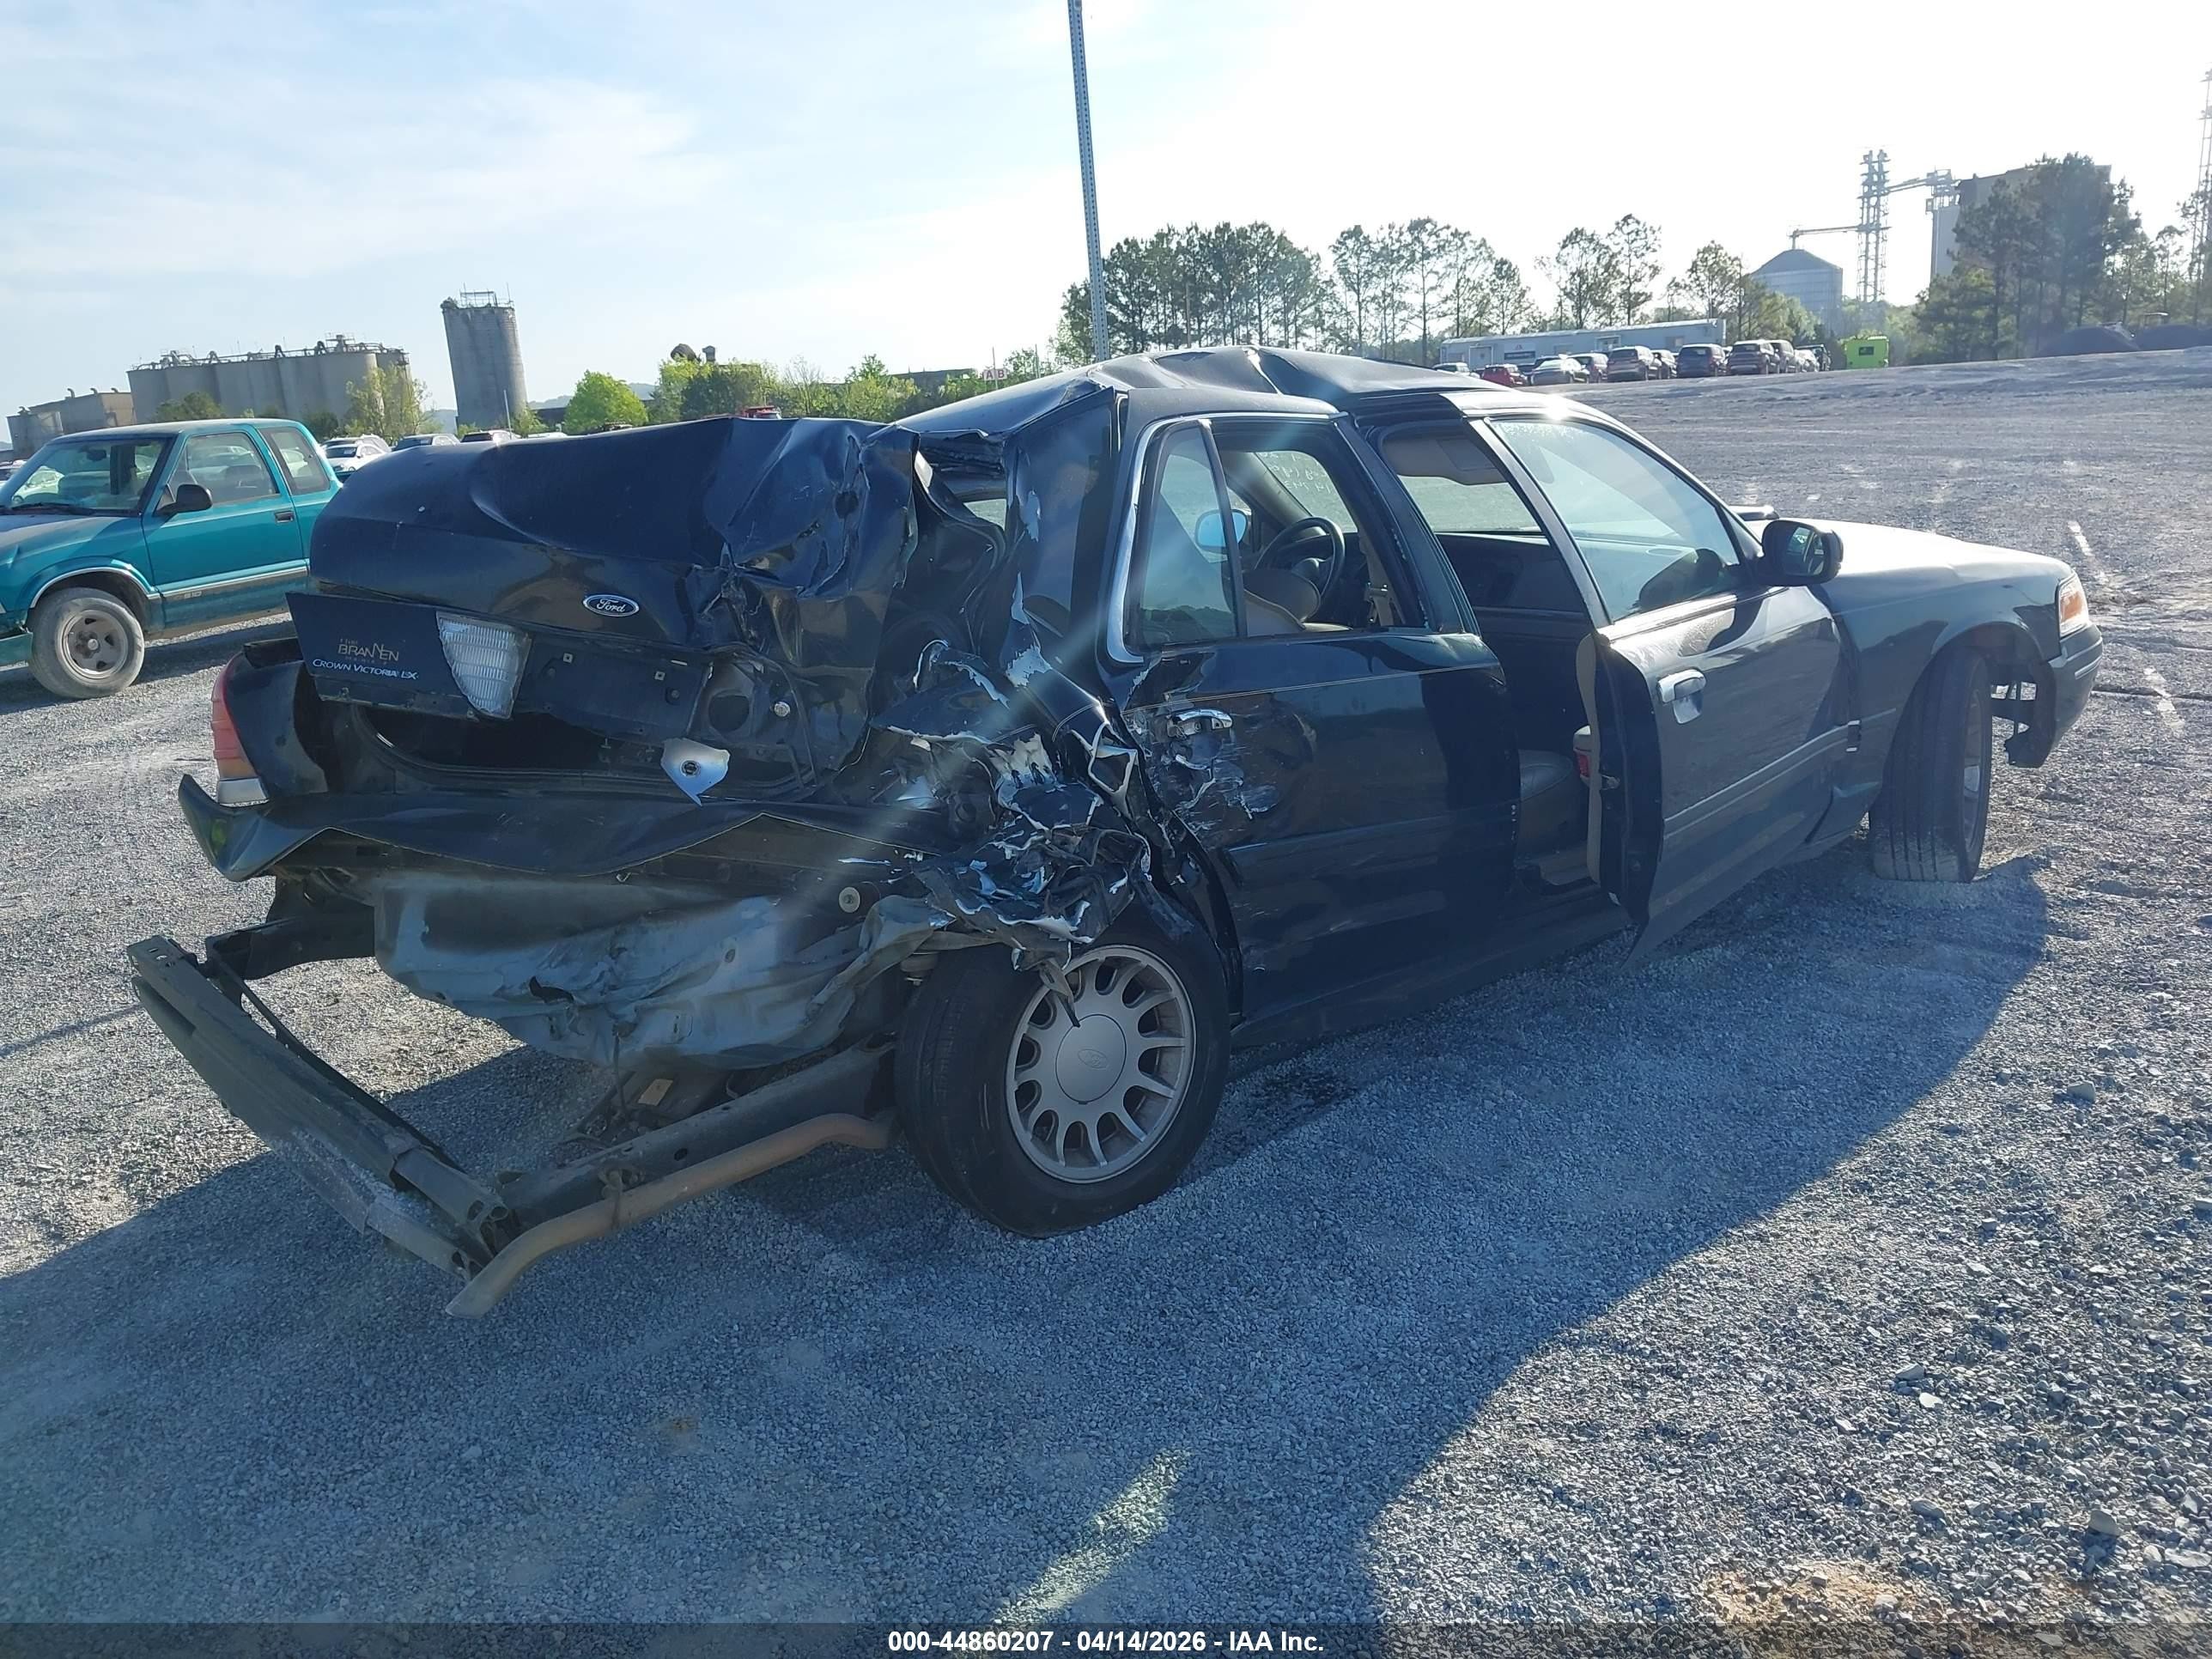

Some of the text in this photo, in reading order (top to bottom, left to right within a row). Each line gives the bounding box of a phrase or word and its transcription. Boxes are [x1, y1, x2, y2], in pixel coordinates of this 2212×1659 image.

[596, 599, 626, 612] Ford
[312, 659, 351, 672] CROWN
[353, 665, 398, 678] VICTORIA
[401, 671, 418, 680] LX
